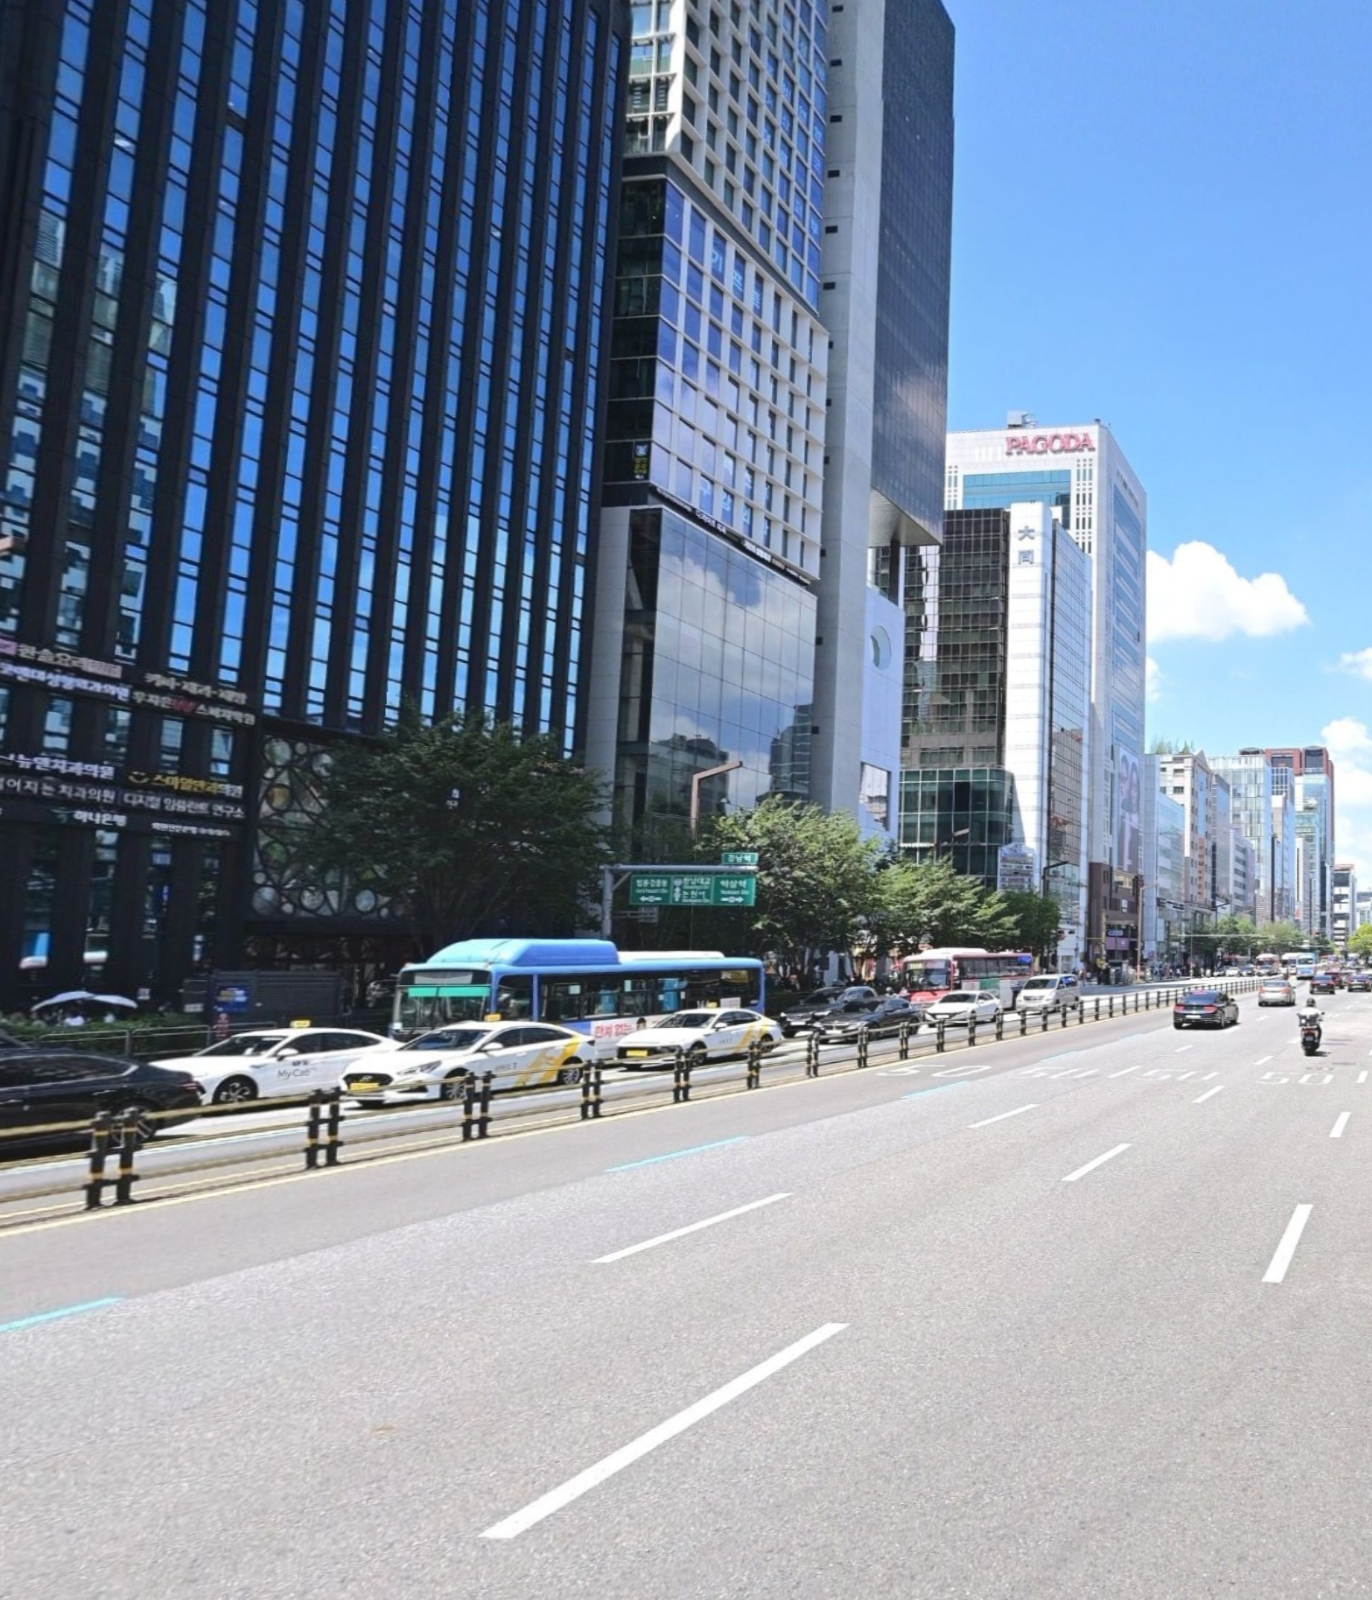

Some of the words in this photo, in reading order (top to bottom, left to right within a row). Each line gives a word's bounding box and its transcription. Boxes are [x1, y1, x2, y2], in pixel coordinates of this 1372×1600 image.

[1006, 432, 1096, 456] PAGODA
[73, 810, 127, 827] 하나은행
[1255, 1071, 1335, 1086] 50
